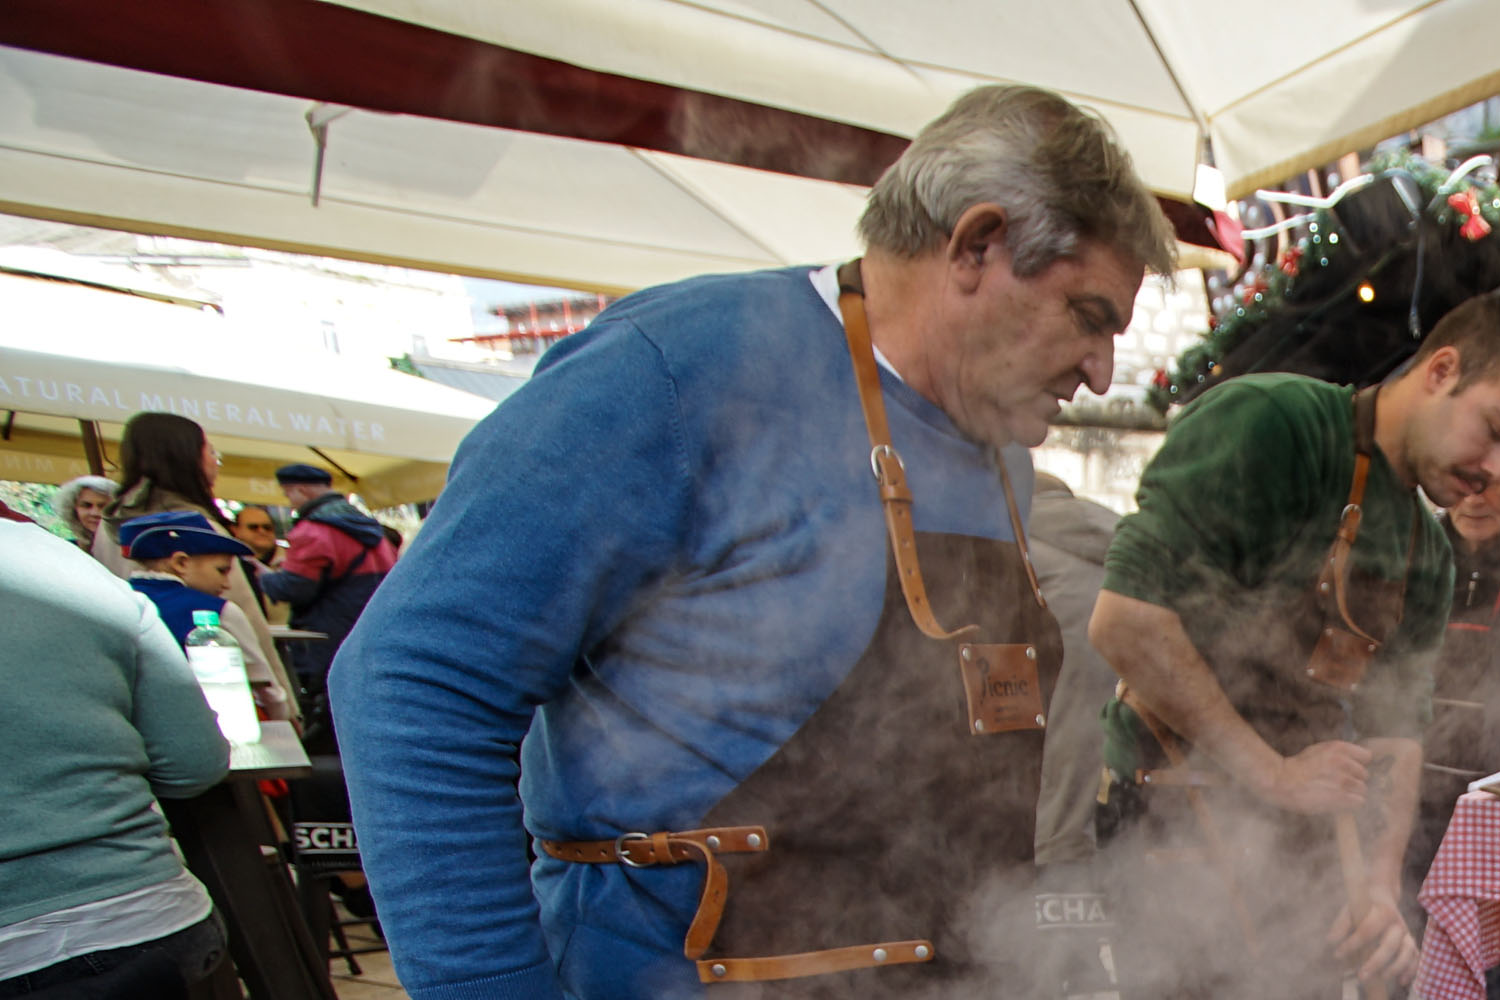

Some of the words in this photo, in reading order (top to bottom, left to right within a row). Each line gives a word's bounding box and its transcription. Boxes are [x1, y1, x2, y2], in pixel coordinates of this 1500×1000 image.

[139, 391, 281, 428] MINERAL
[288, 411, 386, 441] WATER
[976, 656, 1029, 704] Picnic
[295, 828, 359, 849] SCH
